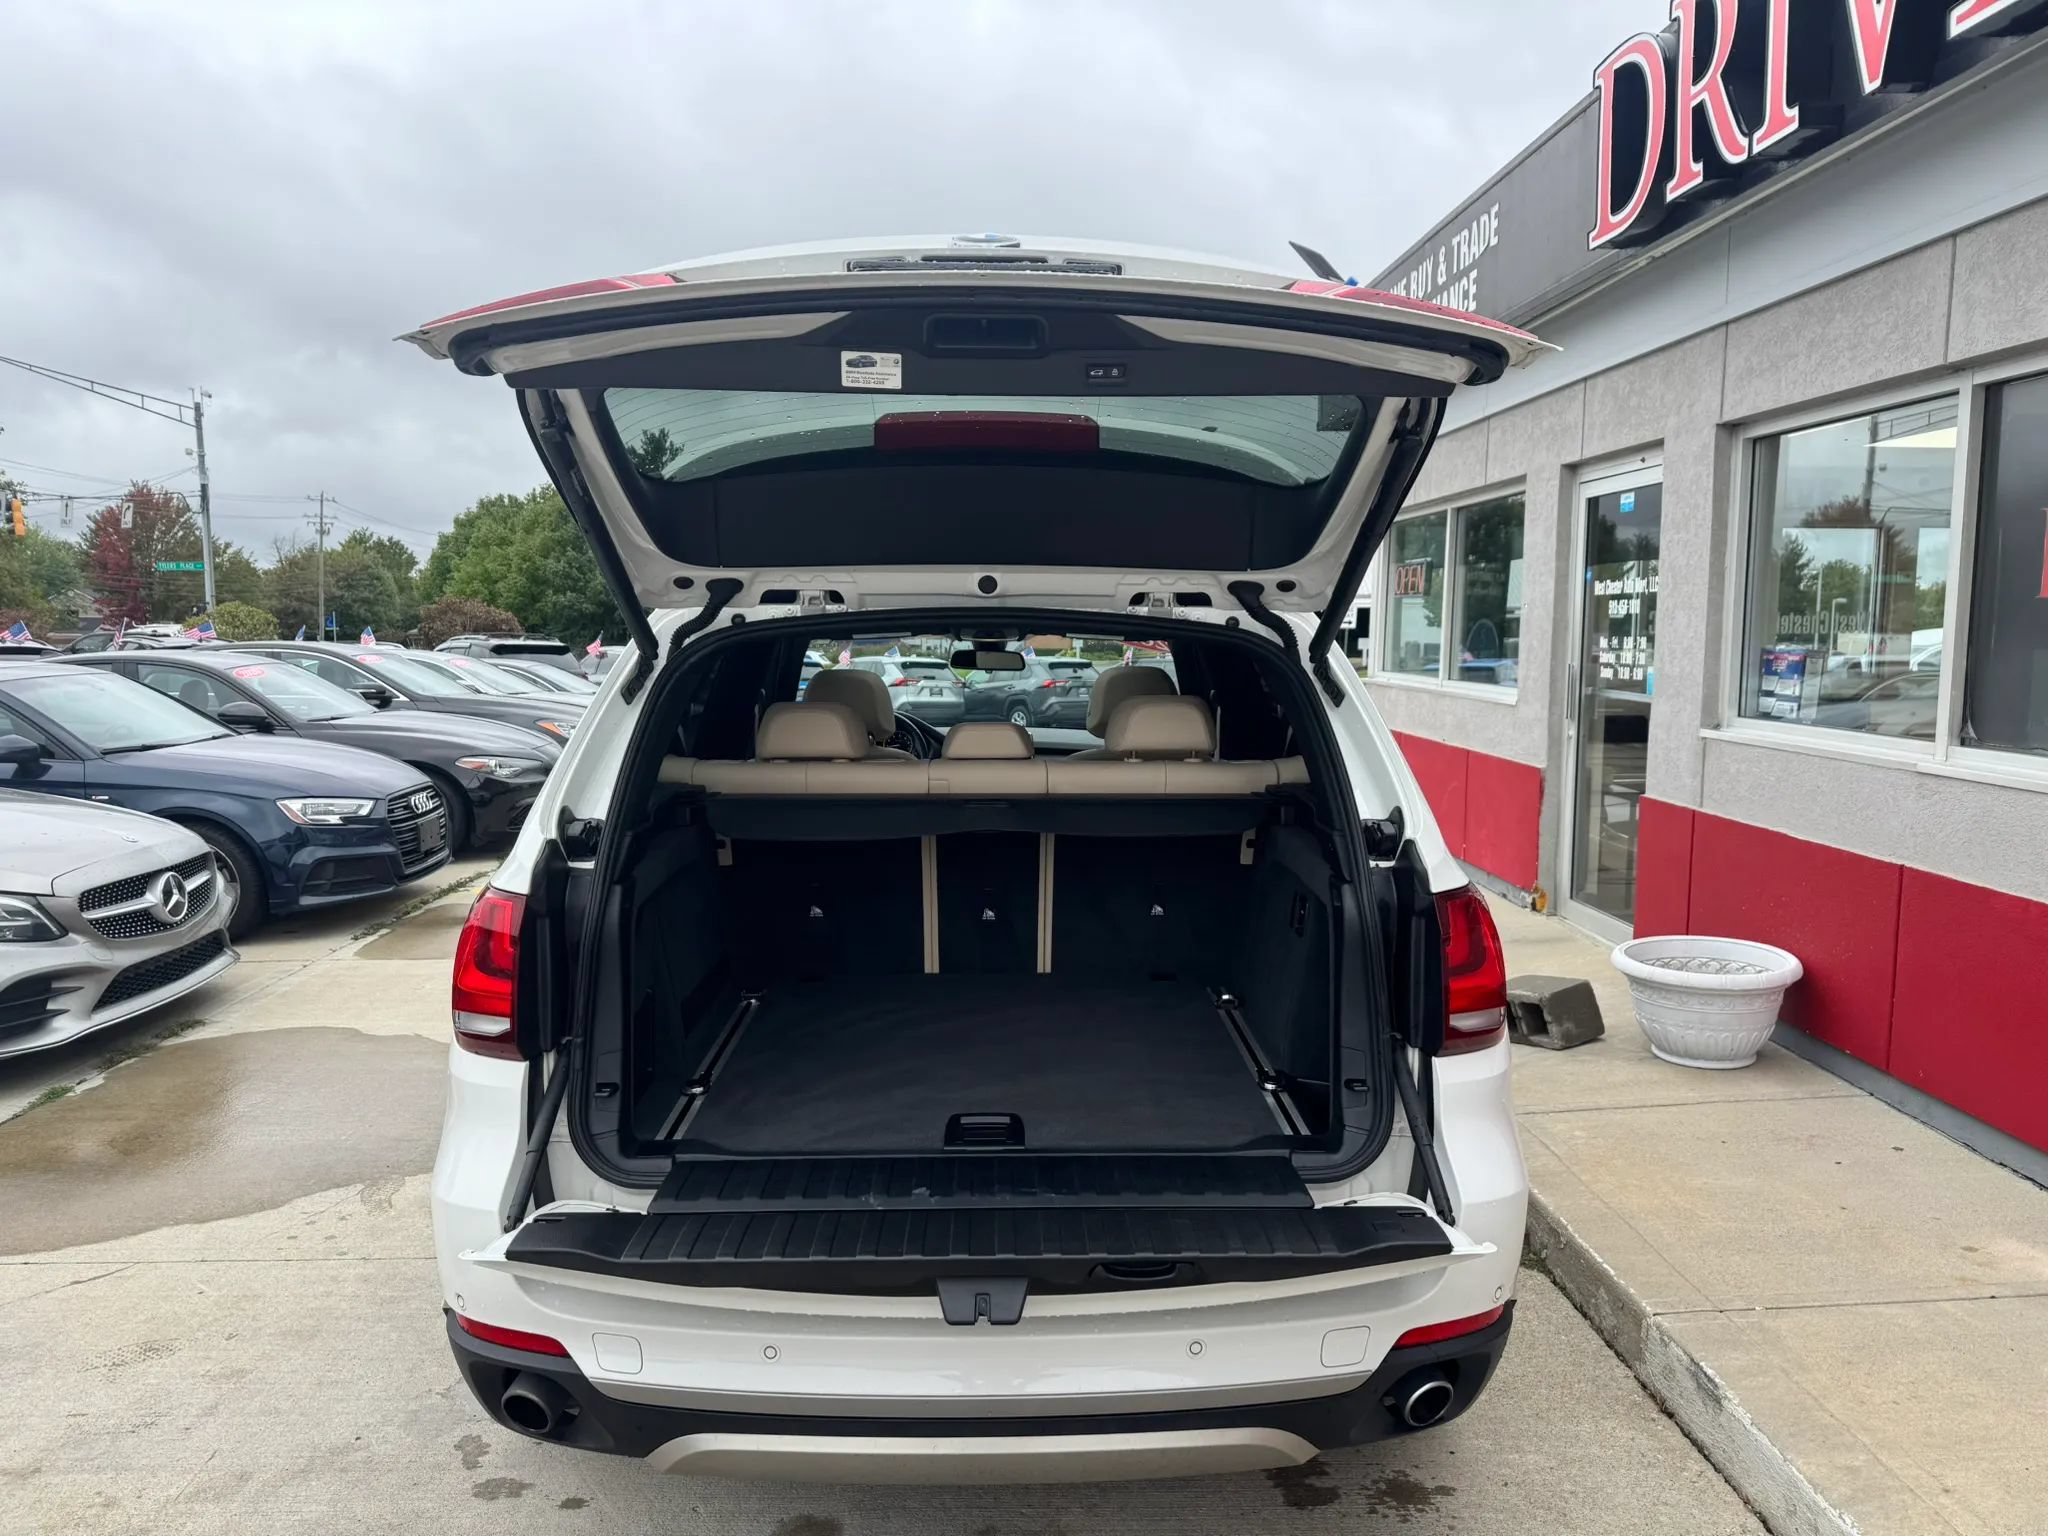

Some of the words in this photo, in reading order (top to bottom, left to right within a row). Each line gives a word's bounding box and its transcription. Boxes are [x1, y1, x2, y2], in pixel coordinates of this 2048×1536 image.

[1588, 0, 2018, 250] DRI
[1410, 253, 1434, 300] BUY
[1437, 245, 1447, 286] &
[1452, 201, 1499, 275] TRADE
[1395, 564, 1424, 594] OPEN
[1594, 579, 1605, 595] West
[1606, 579, 1623, 594] Chester
[1600, 666, 1613, 680] Sunday
